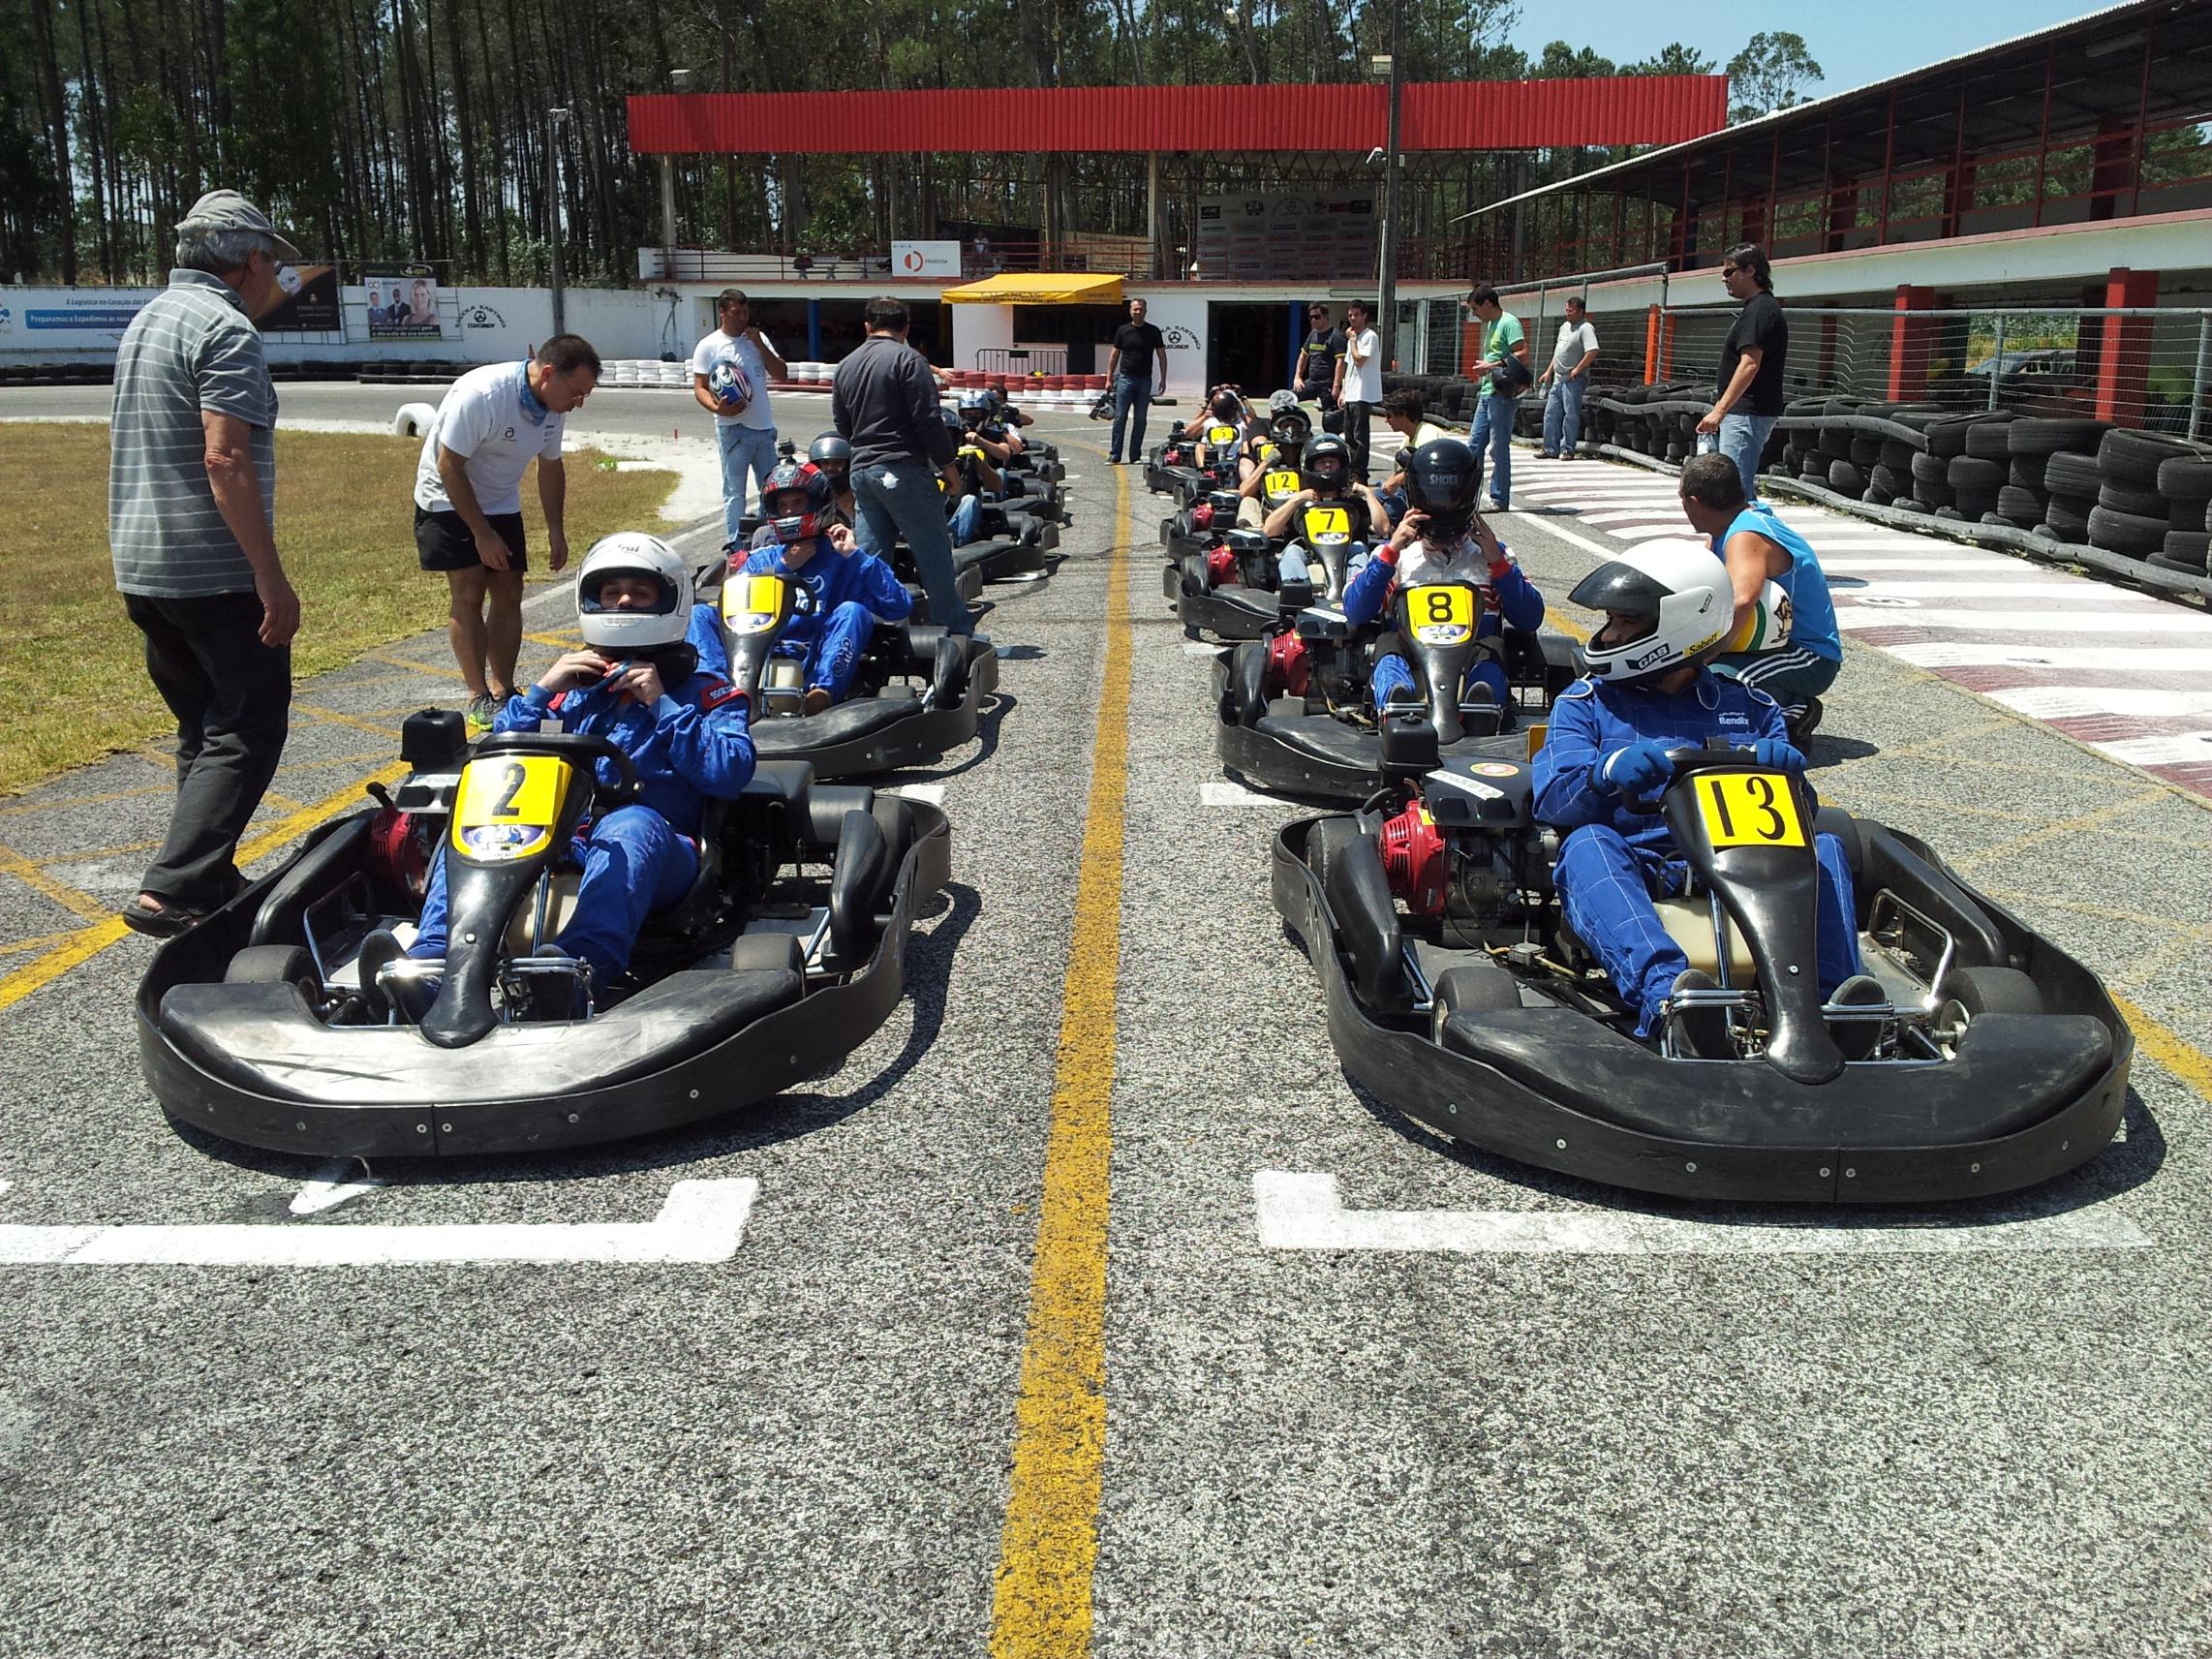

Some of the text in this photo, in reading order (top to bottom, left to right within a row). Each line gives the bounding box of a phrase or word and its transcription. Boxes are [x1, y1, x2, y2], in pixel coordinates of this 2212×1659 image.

[30, 315, 69, 324] Preparamos
[1272, 474, 1290, 490] 12
[1319, 510, 1336, 530] 7
[1427, 592, 1453, 622] 8
[1638, 645, 1669, 669] GAS
[1718, 717, 1750, 726] Bendix
[491, 762, 527, 817] 2
[1709, 776, 1786, 841] 13
